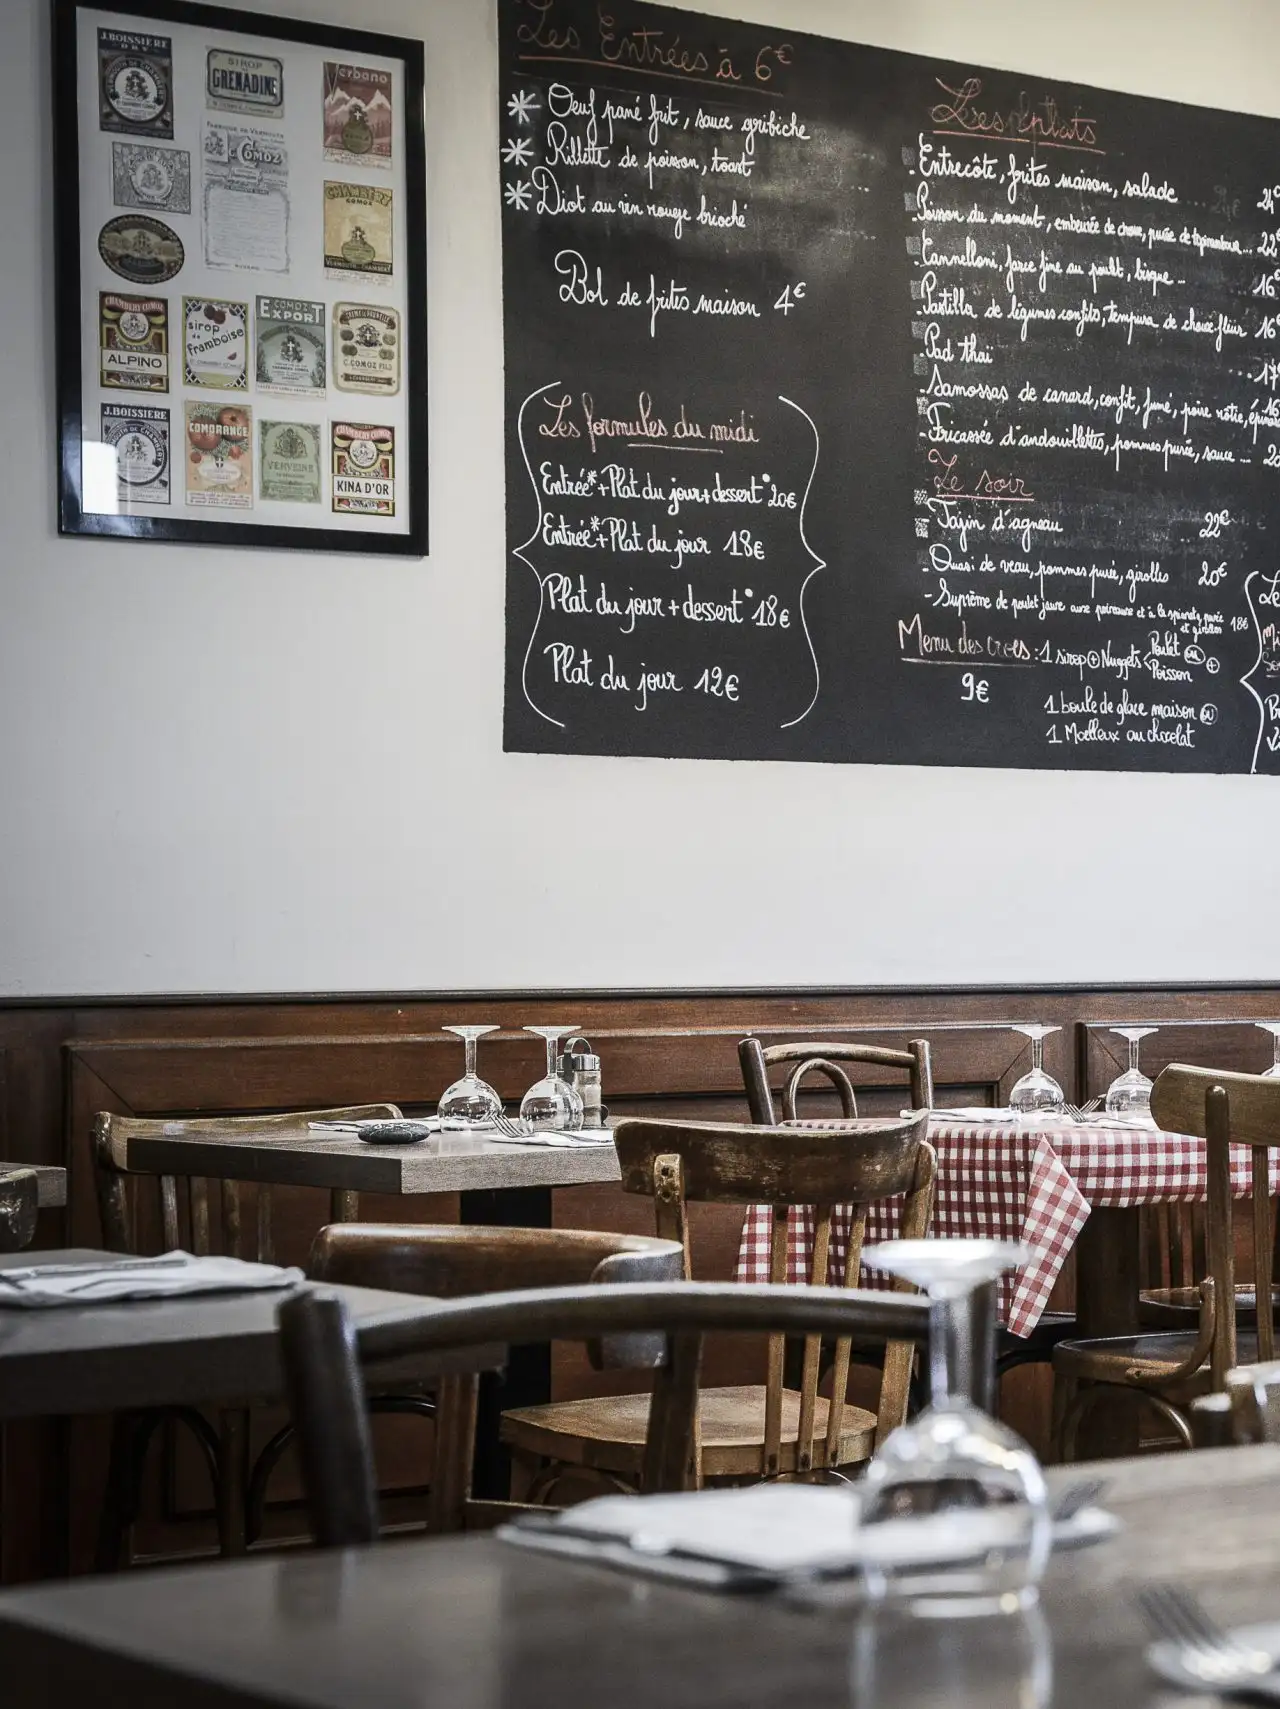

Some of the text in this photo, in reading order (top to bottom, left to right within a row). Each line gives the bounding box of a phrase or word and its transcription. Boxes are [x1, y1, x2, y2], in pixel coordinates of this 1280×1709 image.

[599, 8, 709, 72] Entrées
[716, 48, 741, 79] à
[213, 68, 277, 97] GRENADINE
[602, 96, 810, 155] pané sauce gribiche
[618, 146, 638, 168] de
[711, 148, 755, 176] toast
[1008, 153, 1178, 204] frites salade
[532, 166, 748, 239] Diot au vin rouge brioché
[967, 203, 987, 222] du
[1039, 250, 1063, 293] fine
[1066, 263, 1084, 275] au
[1252, 269, 1280, 296] 16€
[554, 249, 807, 337] Bol de frites maison 4€
[921, 271, 978, 318] Pastilla
[984, 298, 1003, 318] de
[1008, 295, 1056, 342] légumes
[1163, 313, 1177, 330] de
[186, 328, 245, 356] framboise
[188, 320, 220, 335] sirop
[924, 322, 955, 362] Pad
[108, 354, 163, 369] ALPINO
[926, 364, 1009, 402] Samossas
[1018, 381, 1037, 401] de
[189, 422, 248, 437] COMORANGE
[538, 391, 760, 453] Les formules du midi
[928, 449, 1034, 497] Le soir
[1202, 445, 1235, 462] sauce
[337, 480, 389, 495] KINA D'OR
[643, 473, 797, 508] du 20€
[1199, 509, 1230, 538] 22€
[647, 524, 765, 569] du jour 18€
[929, 543, 975, 572] Quasi
[979, 553, 996, 572] de
[1198, 560, 1227, 586] 20€
[541, 573, 790, 634] Plat du jour dessert 18€
[996, 589, 1008, 610] de
[898, 613, 954, 656] Menu
[958, 620, 984, 654] des
[1101, 640, 1143, 680] Nuggets
[544, 642, 739, 711] Plat du jour 12€
[961, 672, 990, 703] 9€
[1149, 658, 1193, 682] Poisson
[1044, 685, 1197, 725] 1 boule de glace maison
[1046, 718, 1195, 748] 1 Moelleux au chocolat
